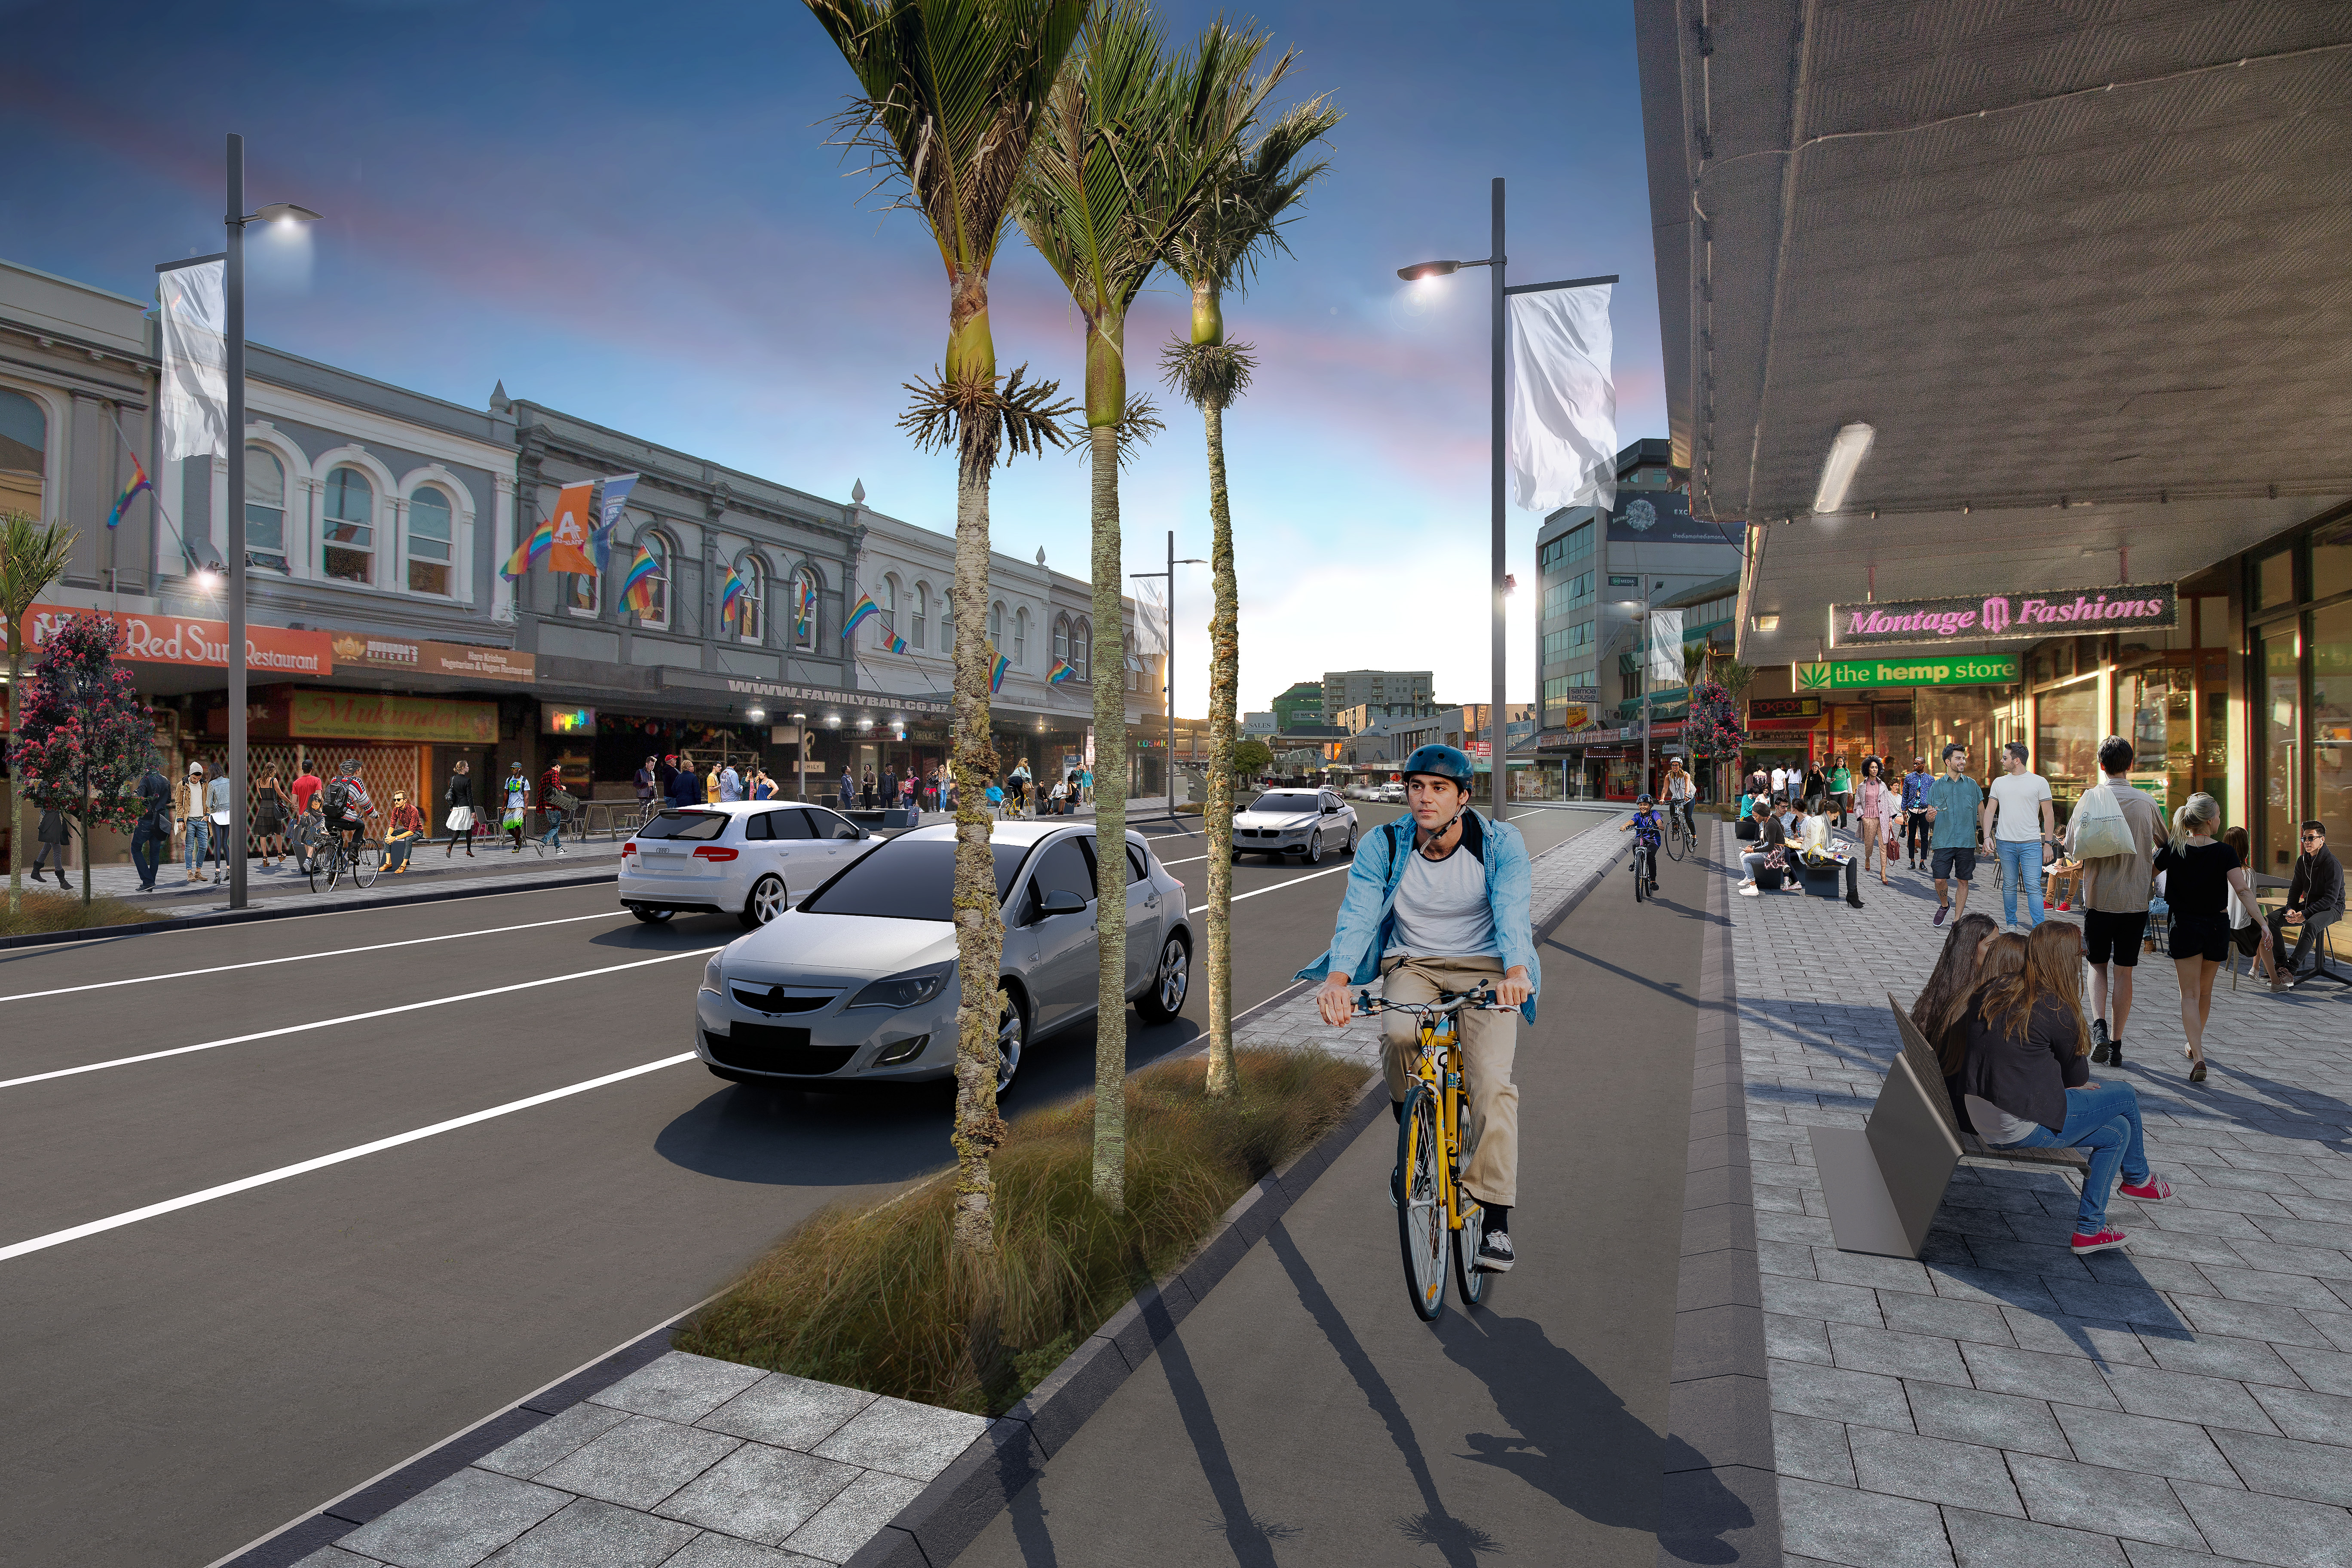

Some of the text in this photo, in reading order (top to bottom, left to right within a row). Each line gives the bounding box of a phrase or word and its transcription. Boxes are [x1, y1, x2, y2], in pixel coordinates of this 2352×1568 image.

[1847, 608, 1977, 635] Montage
[2016, 595, 2164, 625] Fashions
[126, 618, 183, 659] Red
[246, 640, 318, 670] Restaurant
[1835, 661, 2016, 683] the hemp store
[298, 697, 471, 729] Mukunda's
